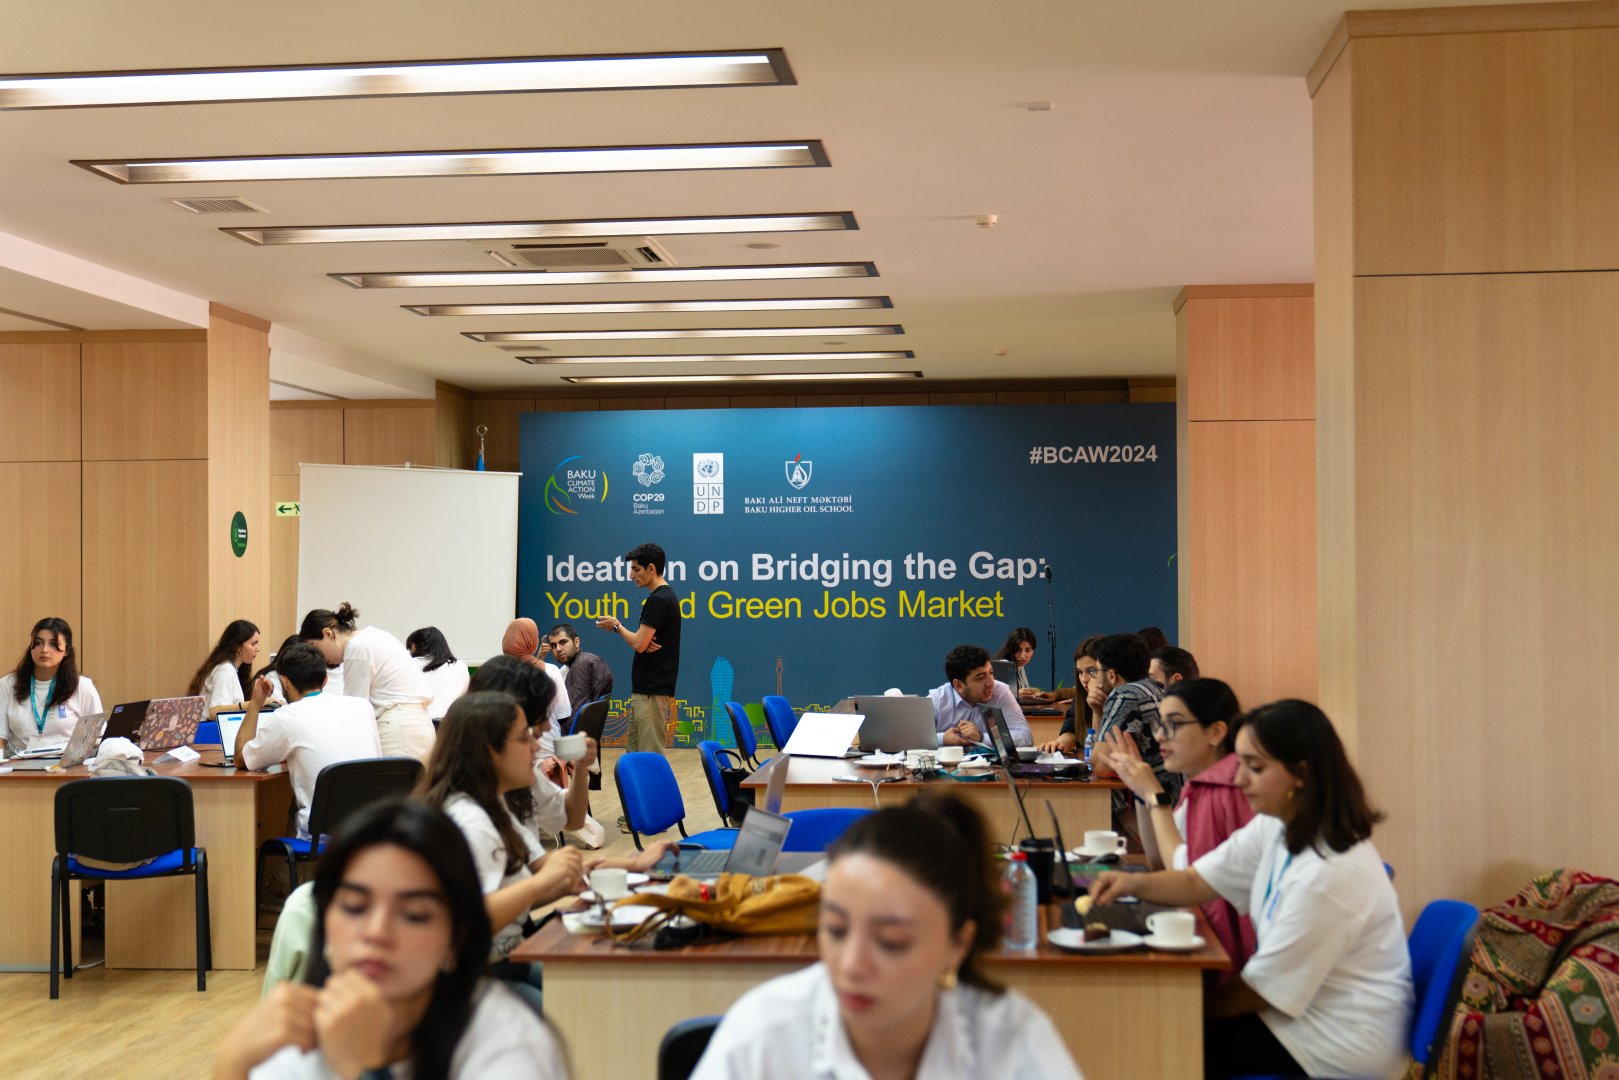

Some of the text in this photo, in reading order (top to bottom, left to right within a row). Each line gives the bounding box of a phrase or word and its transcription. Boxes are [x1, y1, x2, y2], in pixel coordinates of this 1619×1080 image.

[1029, 444, 1158, 464] #BCAW2024
[567, 470, 596, 479] BAKU
[633, 493, 665, 502] COP29
[744, 497, 766, 505] BAKI
[786, 496, 807, 504] NEFT
[819, 505, 854, 513] SCHOOL
[546, 551, 1046, 587] Ideatin on Bridging the Gap:
[545, 591, 629, 619] Youth
[708, 590, 802, 619] Green
[813, 590, 887, 619] Jobs
[899, 589, 1004, 618] Market
